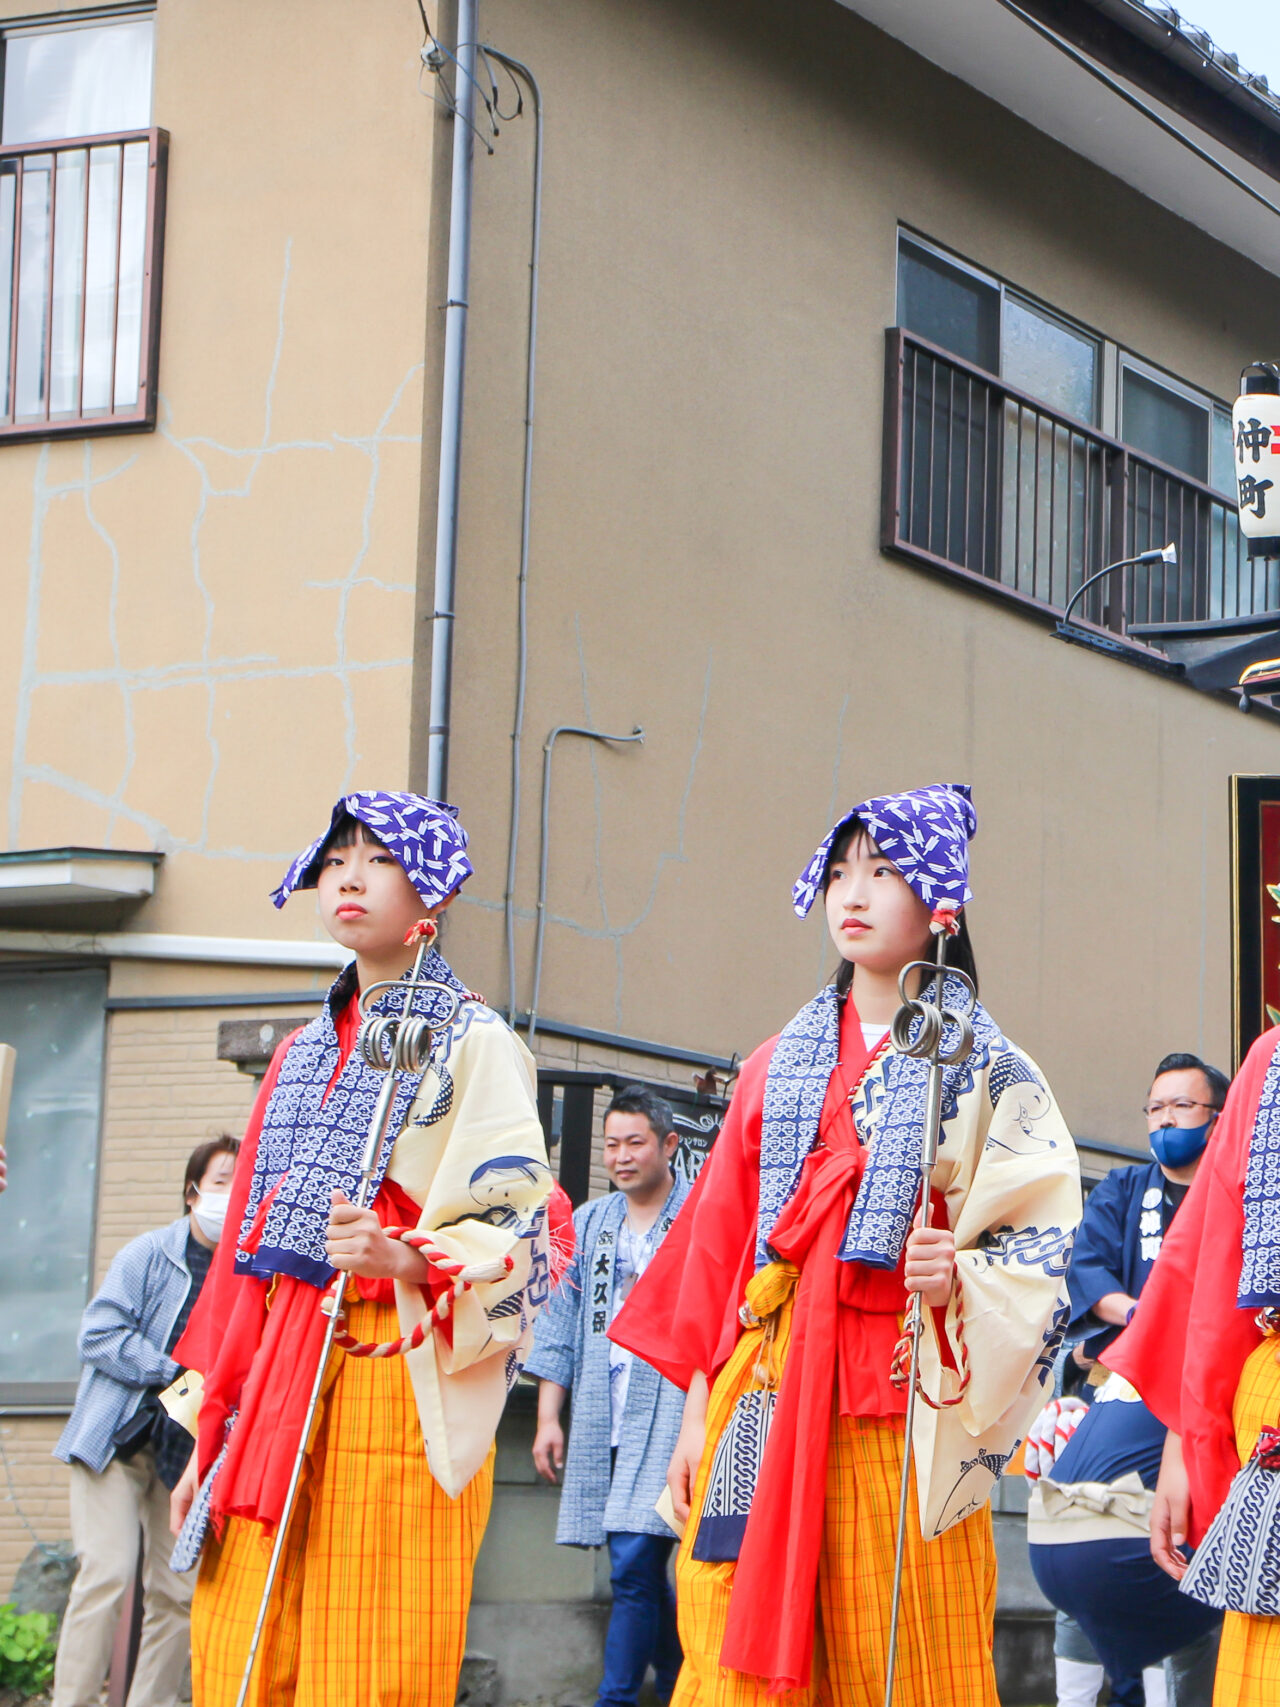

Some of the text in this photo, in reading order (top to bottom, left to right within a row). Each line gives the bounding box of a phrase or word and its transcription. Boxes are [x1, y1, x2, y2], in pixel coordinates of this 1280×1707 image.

[1237, 418, 1274, 519] 仲町
[593, 1253, 610, 1334] 大久保
